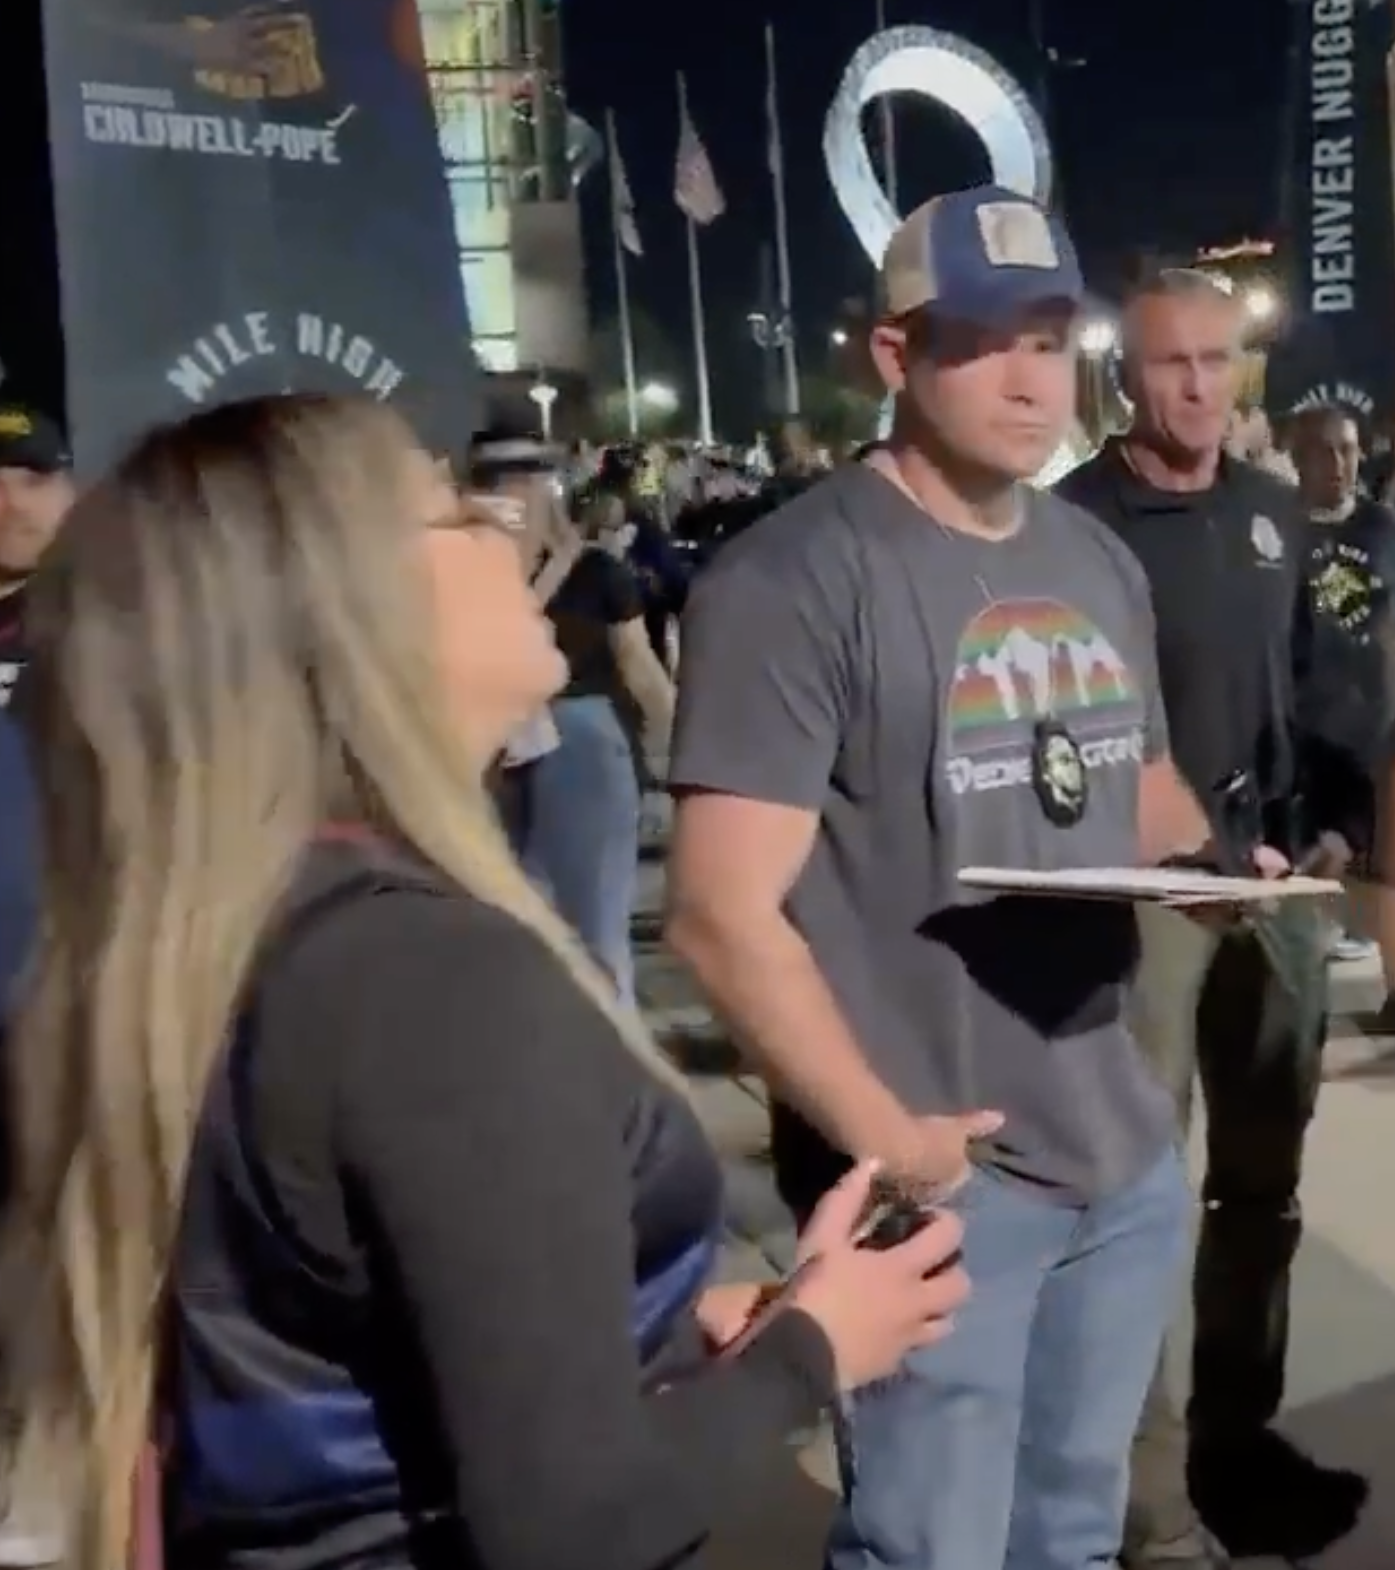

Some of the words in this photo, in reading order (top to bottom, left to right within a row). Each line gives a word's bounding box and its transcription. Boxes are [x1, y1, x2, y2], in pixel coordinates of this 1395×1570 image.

[1312, 135, 1354, 313] DENVER
[167, 311, 276, 402] MILE
[297, 313, 403, 401] HIGH
